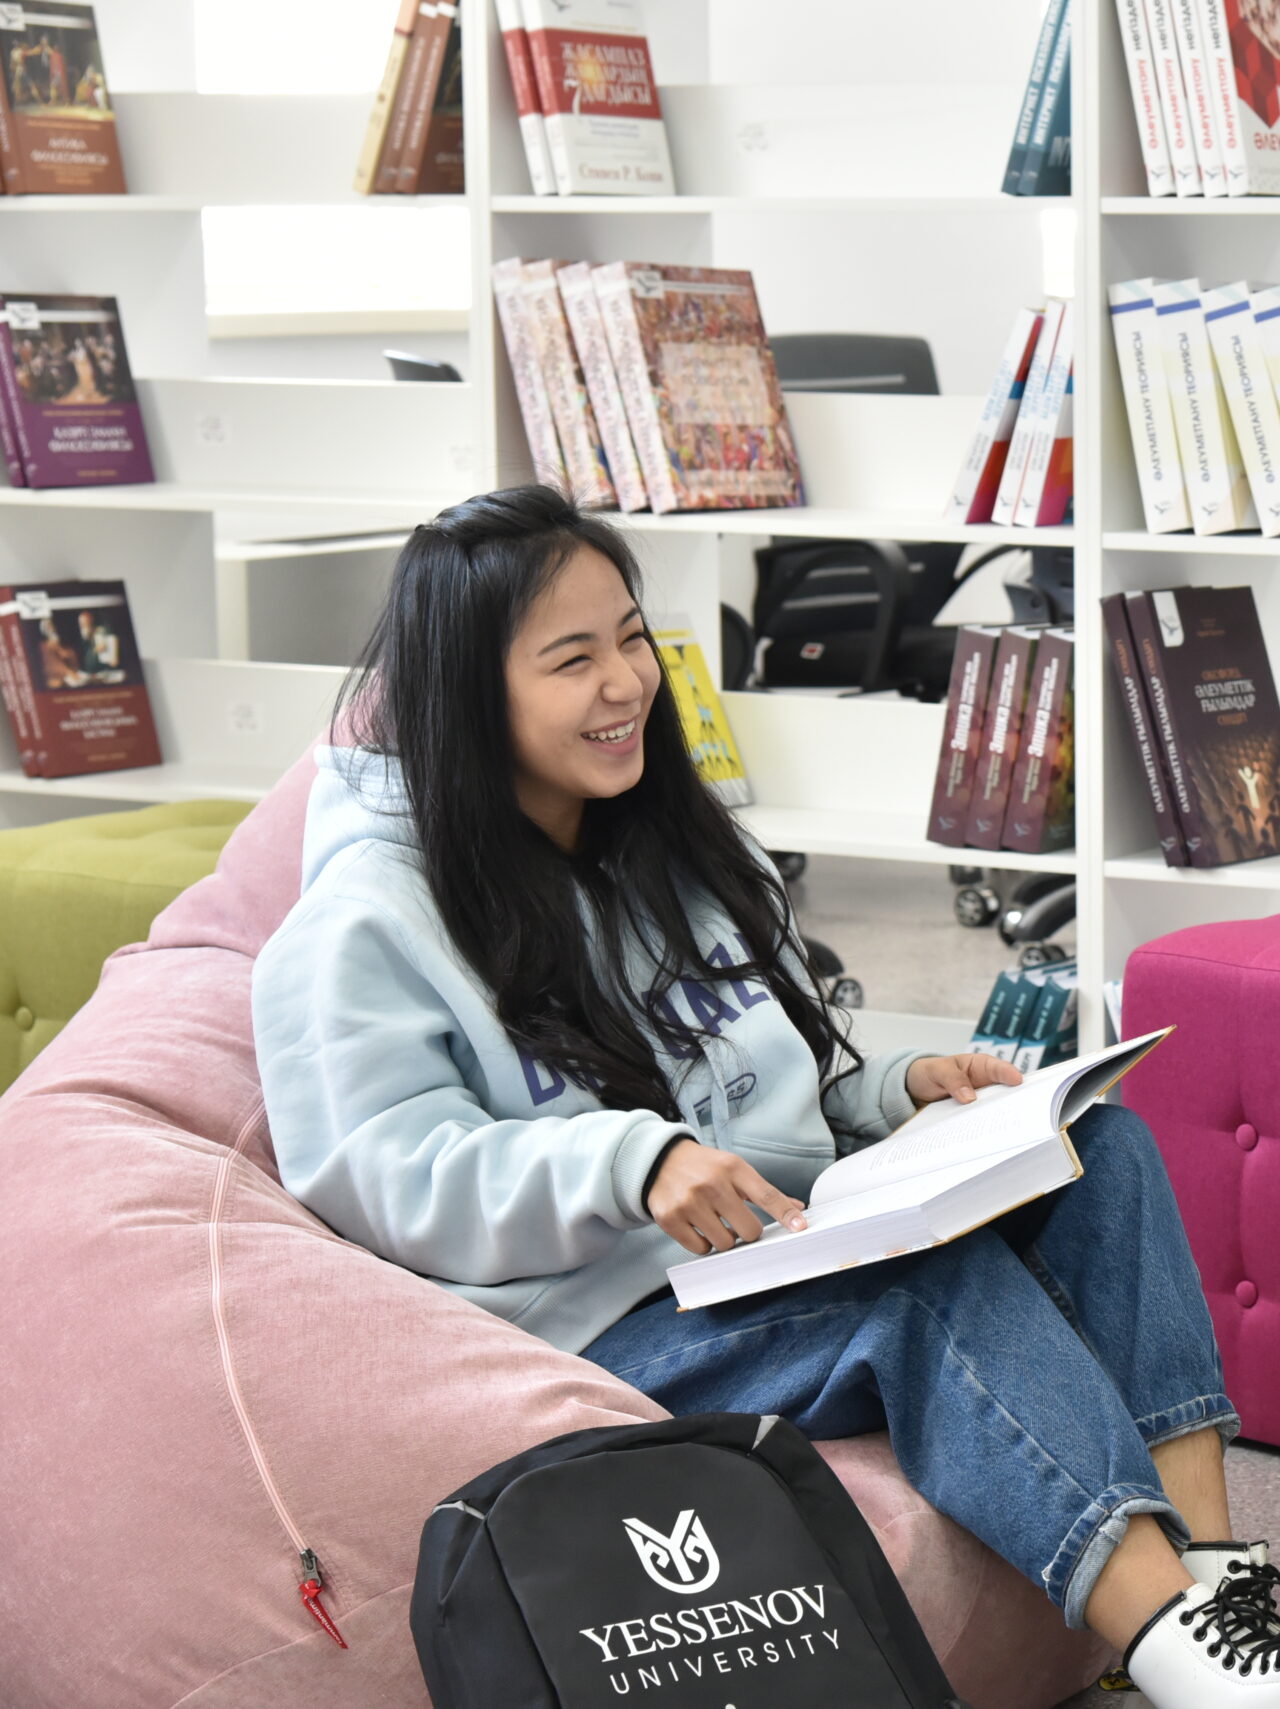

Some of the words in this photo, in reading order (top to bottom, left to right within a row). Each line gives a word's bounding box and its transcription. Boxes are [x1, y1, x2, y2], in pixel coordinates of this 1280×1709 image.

[1014, 84, 1041, 146] ИНТЕРНЕТ
[1131, 331, 1152, 394] ТЕОРИЯСЫ
[1178, 331, 1198, 396] ТЕОРИЯСЫ
[1231, 335, 1254, 404] ТЕОРИЯСЫ
[1124, 676, 1147, 741] ҒЫЛЫМДАР
[1151, 676, 1175, 741] ҒЫЛЫМДАР
[1194, 680, 1256, 699] ӘЛЕУМЕТТІК
[1201, 694, 1256, 714] ҒЫЛЫМДАР
[951, 703, 973, 751] Этика
[989, 706, 1011, 754] Этика
[1028, 709, 1050, 757] Этика
[1140, 741, 1165, 813] ӘЛЕУМЕТТІК
[1165, 741, 1190, 813] ӘЛЕУМЕТТІК
[579, 1585, 825, 1662] YESSENOV
[610, 1629, 839, 1694] UNIVERSITY
